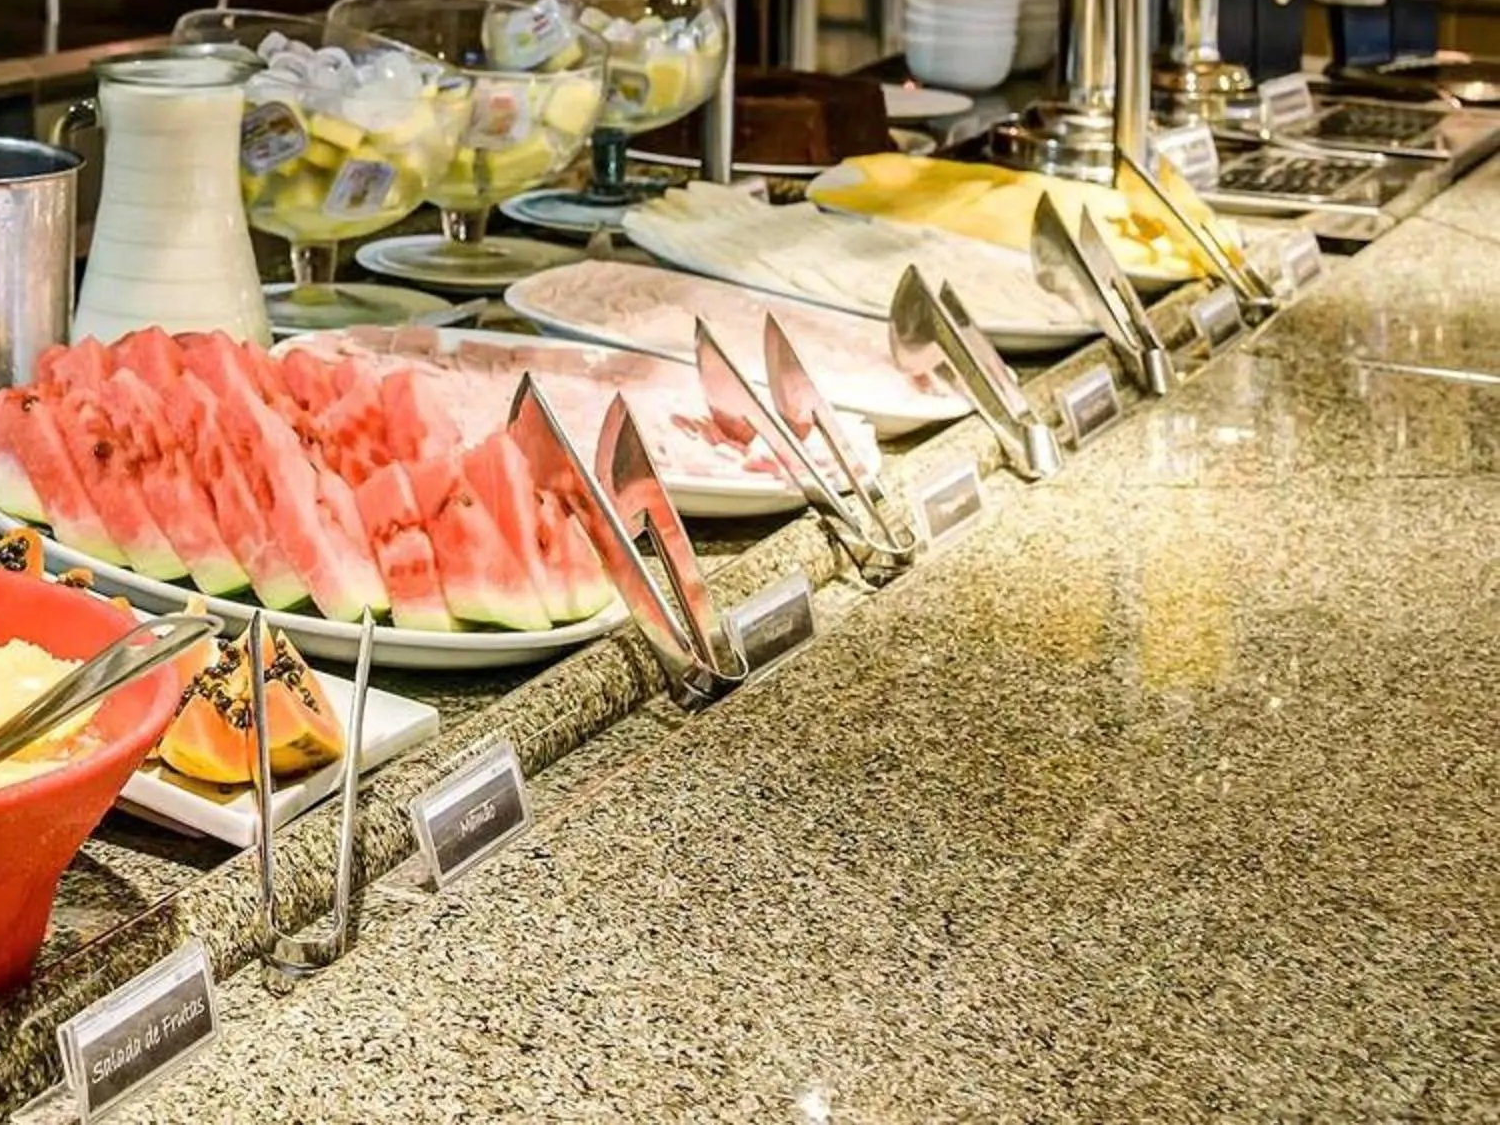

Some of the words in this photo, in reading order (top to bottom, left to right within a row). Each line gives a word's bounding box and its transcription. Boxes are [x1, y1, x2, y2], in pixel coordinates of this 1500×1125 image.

[92, 1036, 143, 1084] Salada
[145, 1025, 161, 1051] de
[162, 995, 205, 1039] Frutas
